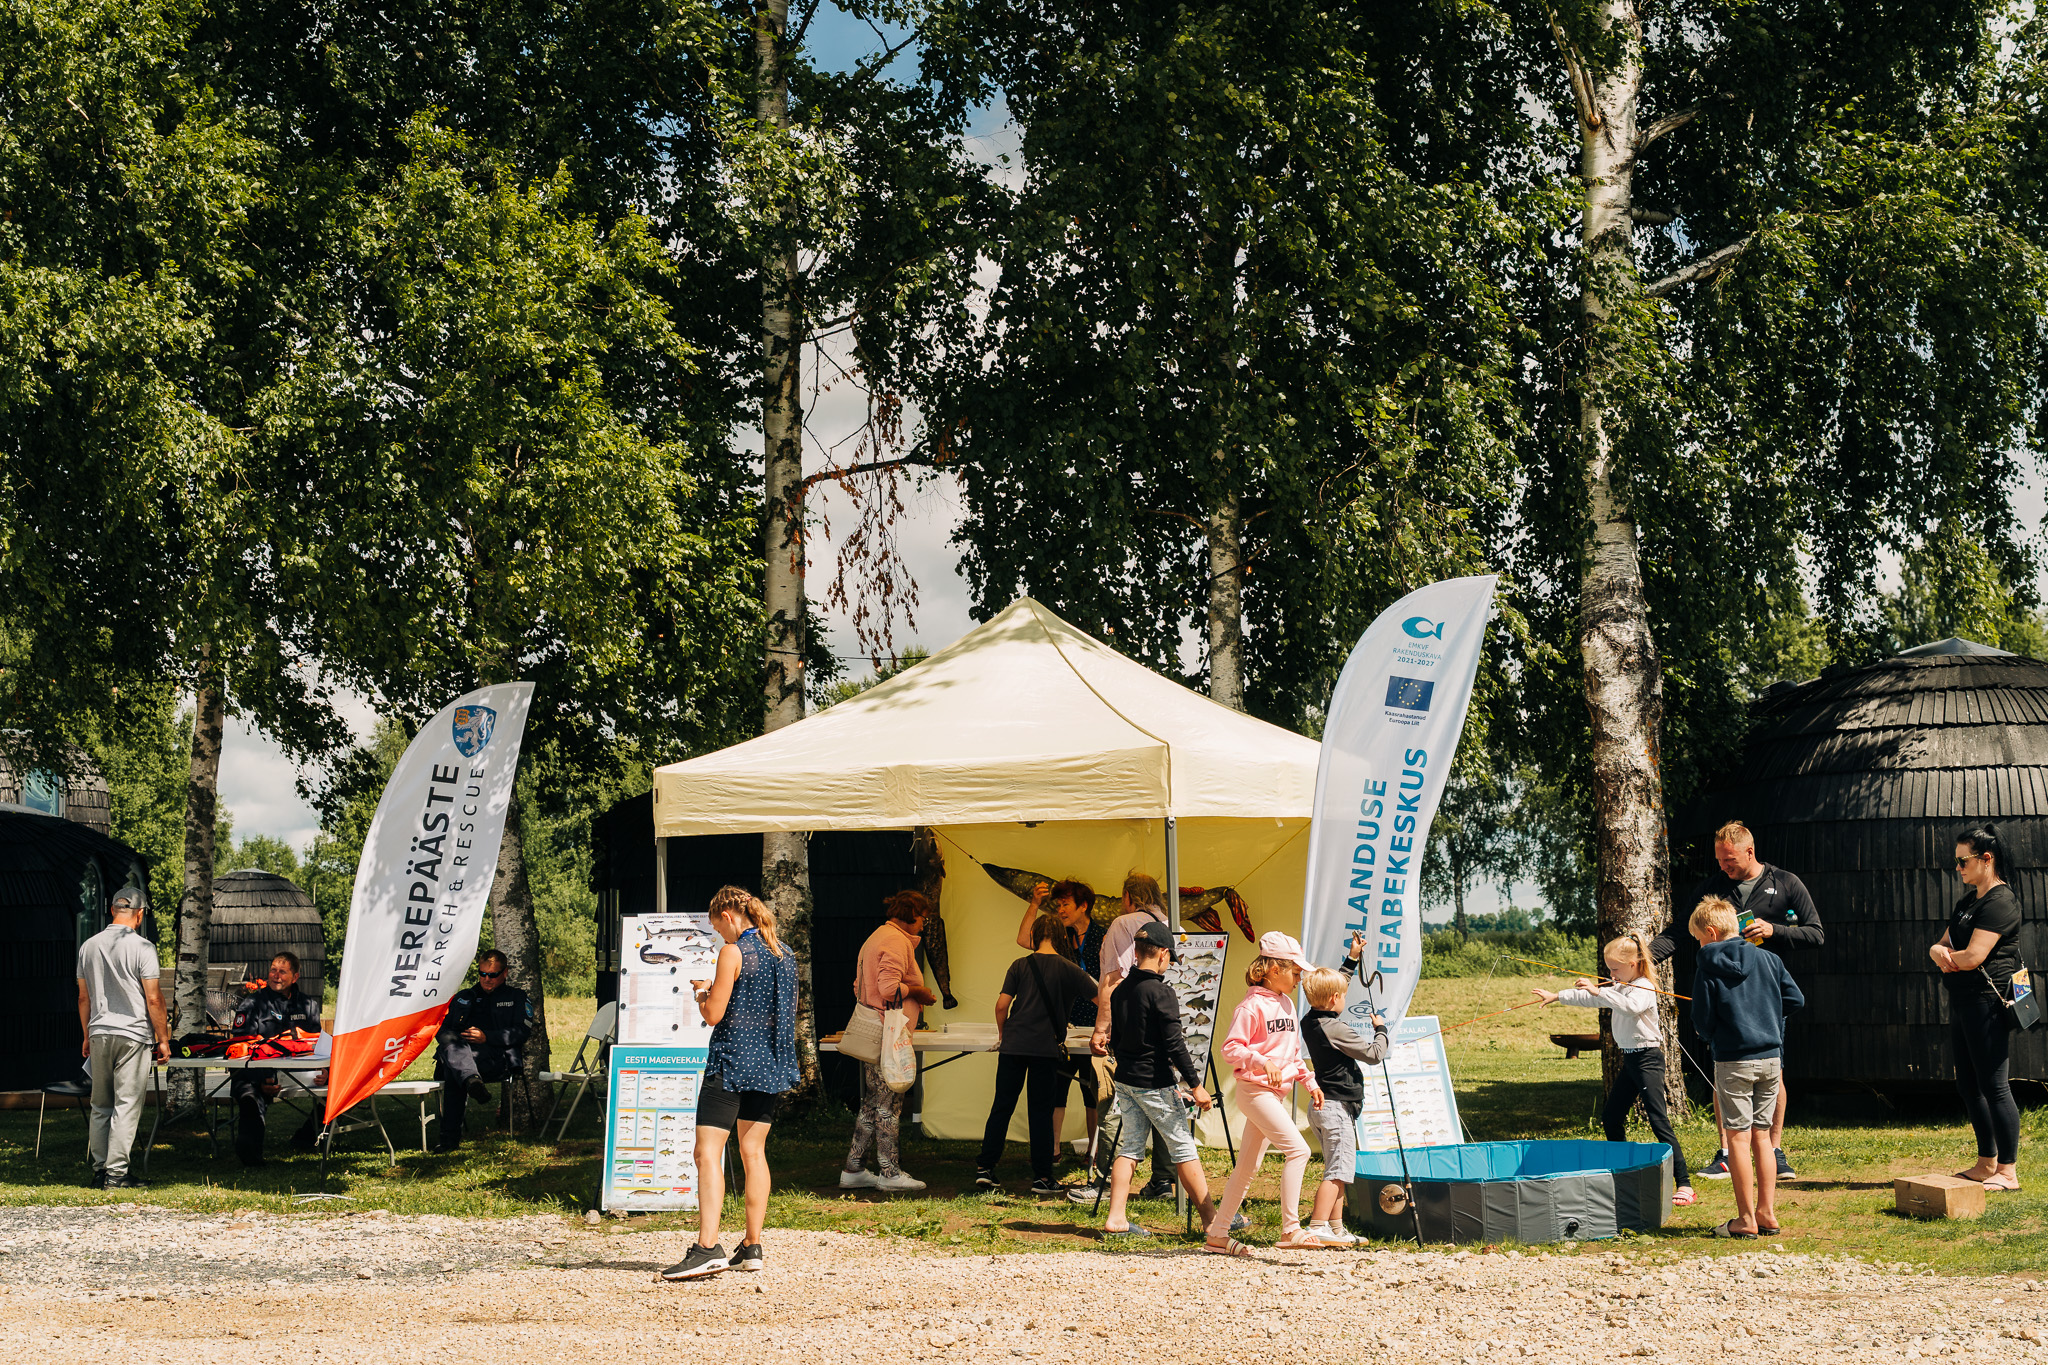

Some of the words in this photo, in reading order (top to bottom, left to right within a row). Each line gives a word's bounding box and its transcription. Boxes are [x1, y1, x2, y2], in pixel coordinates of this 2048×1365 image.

[1408, 642, 1429, 650] EMKVF
[1393, 648, 1441, 660] RAKENDUSKAVA
[1397, 656, 1435, 667] 2021-2027
[1385, 710, 1427, 720] Kaasrahastanud
[1388, 717, 1411, 725] Euroopa
[453, 768, 485, 866] RESCUE
[1376, 748, 1428, 979] TEABEKESKUS
[389, 763, 460, 998] MEREPÄÄSTE
[448, 879, 464, 891] &
[423, 904, 458, 997] SEARCH
[625, 1056, 647, 1064] EESTI
[649, 1056, 708, 1064] MAGEVEEKALA
